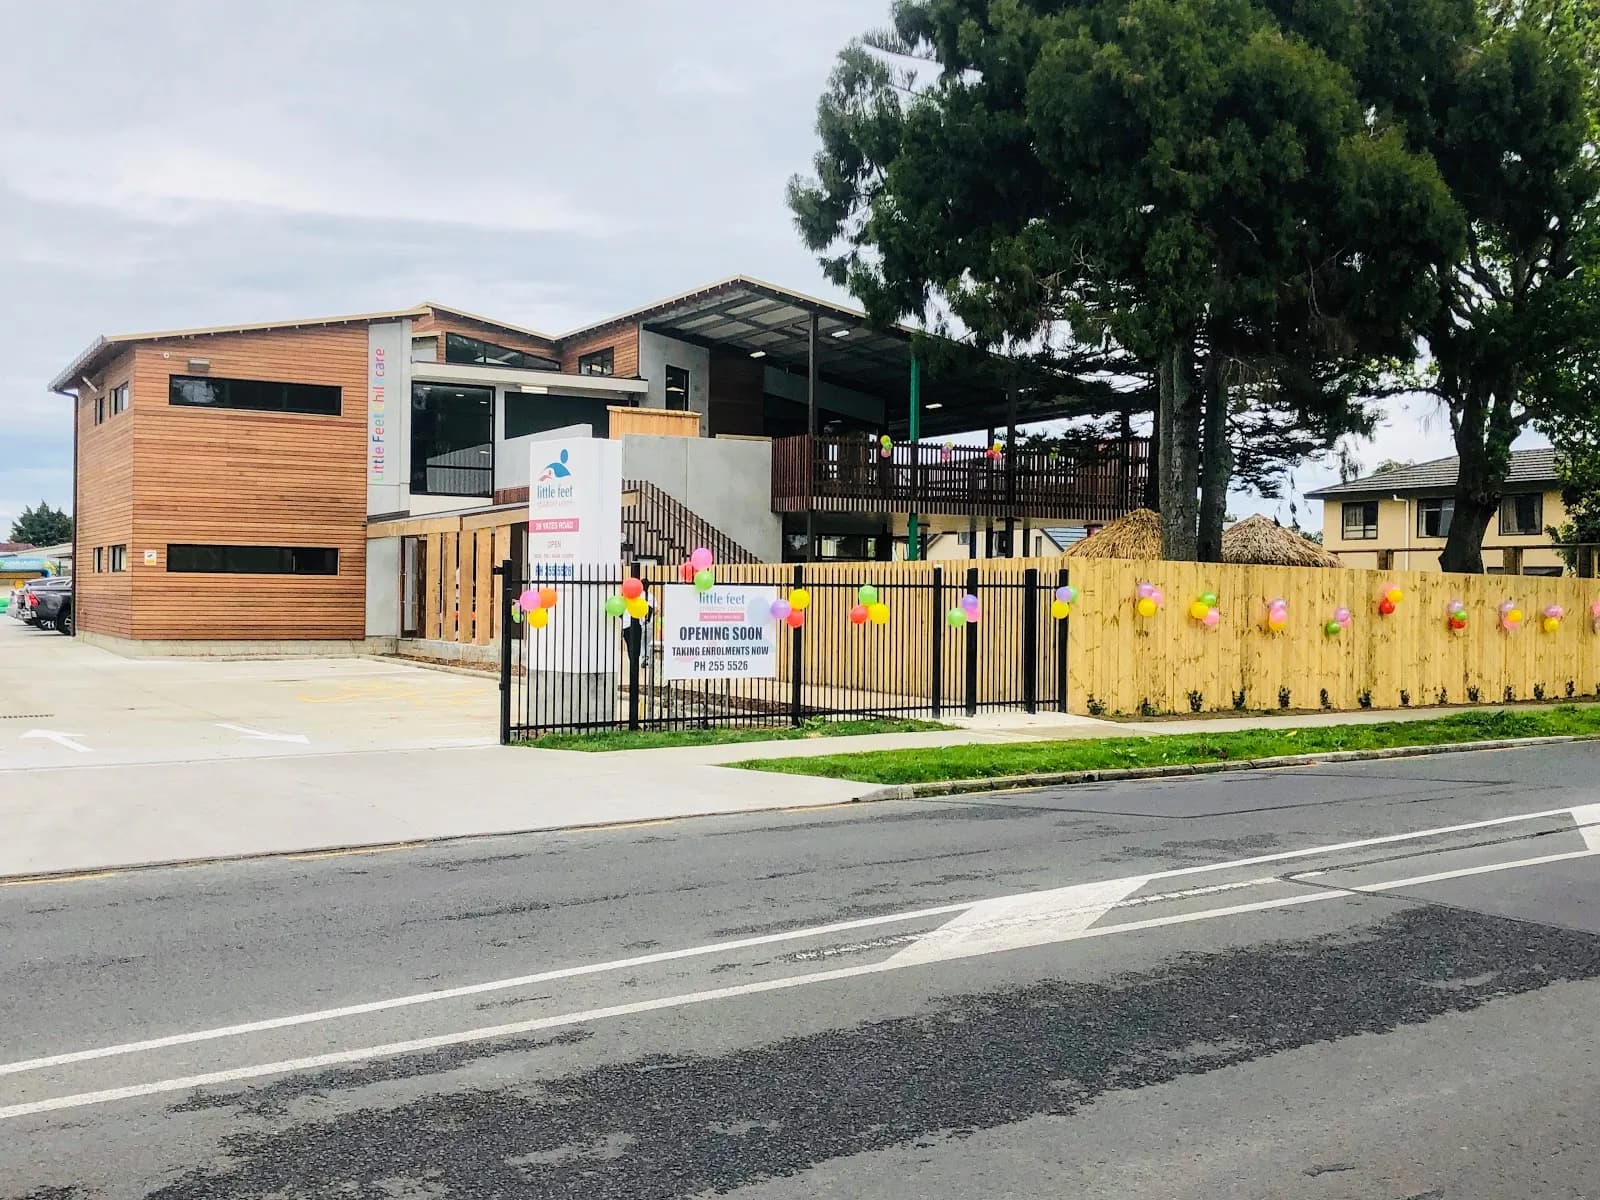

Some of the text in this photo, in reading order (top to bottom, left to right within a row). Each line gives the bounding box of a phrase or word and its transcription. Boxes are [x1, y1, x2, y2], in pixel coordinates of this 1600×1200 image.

[372, 412, 385, 443] Feet
[537, 484, 573, 499] little feet
[558, 520, 574, 529] ROAD
[699, 591, 745, 605] little feet
[679, 626, 763, 641] OPENING SOON
[672, 646, 769, 657] TAKING ENROLMENTS NOW
[693, 660, 749, 672] PH 255 5526
